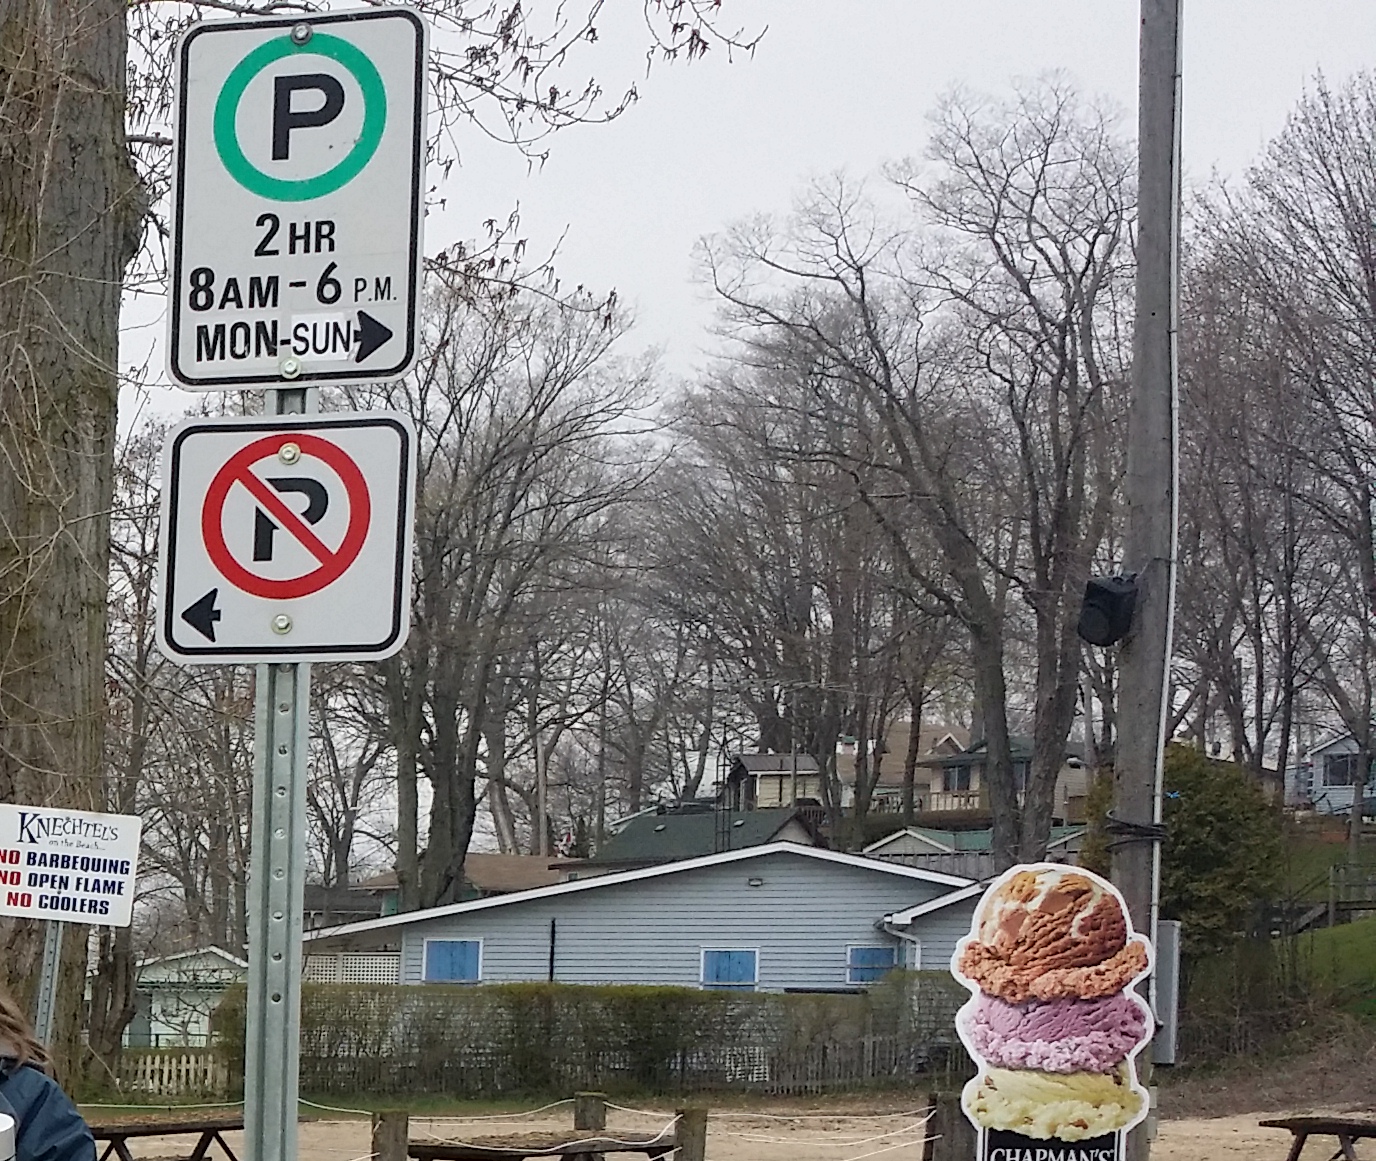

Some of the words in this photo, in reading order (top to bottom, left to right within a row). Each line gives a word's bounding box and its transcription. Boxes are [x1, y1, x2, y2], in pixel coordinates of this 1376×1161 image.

[271, 73, 345, 161] P
[254, 213, 280, 257] 2
[288, 219, 336, 254] HR
[16, 812, 118, 844] KNECHTEL'S
[26, 851, 130, 875] BARBEQUING
[27, 872, 69, 890] OPEN
[75, 877, 125, 896] FLAME
[6, 892, 32, 908] NO
[38, 894, 109, 915] COOLERS
